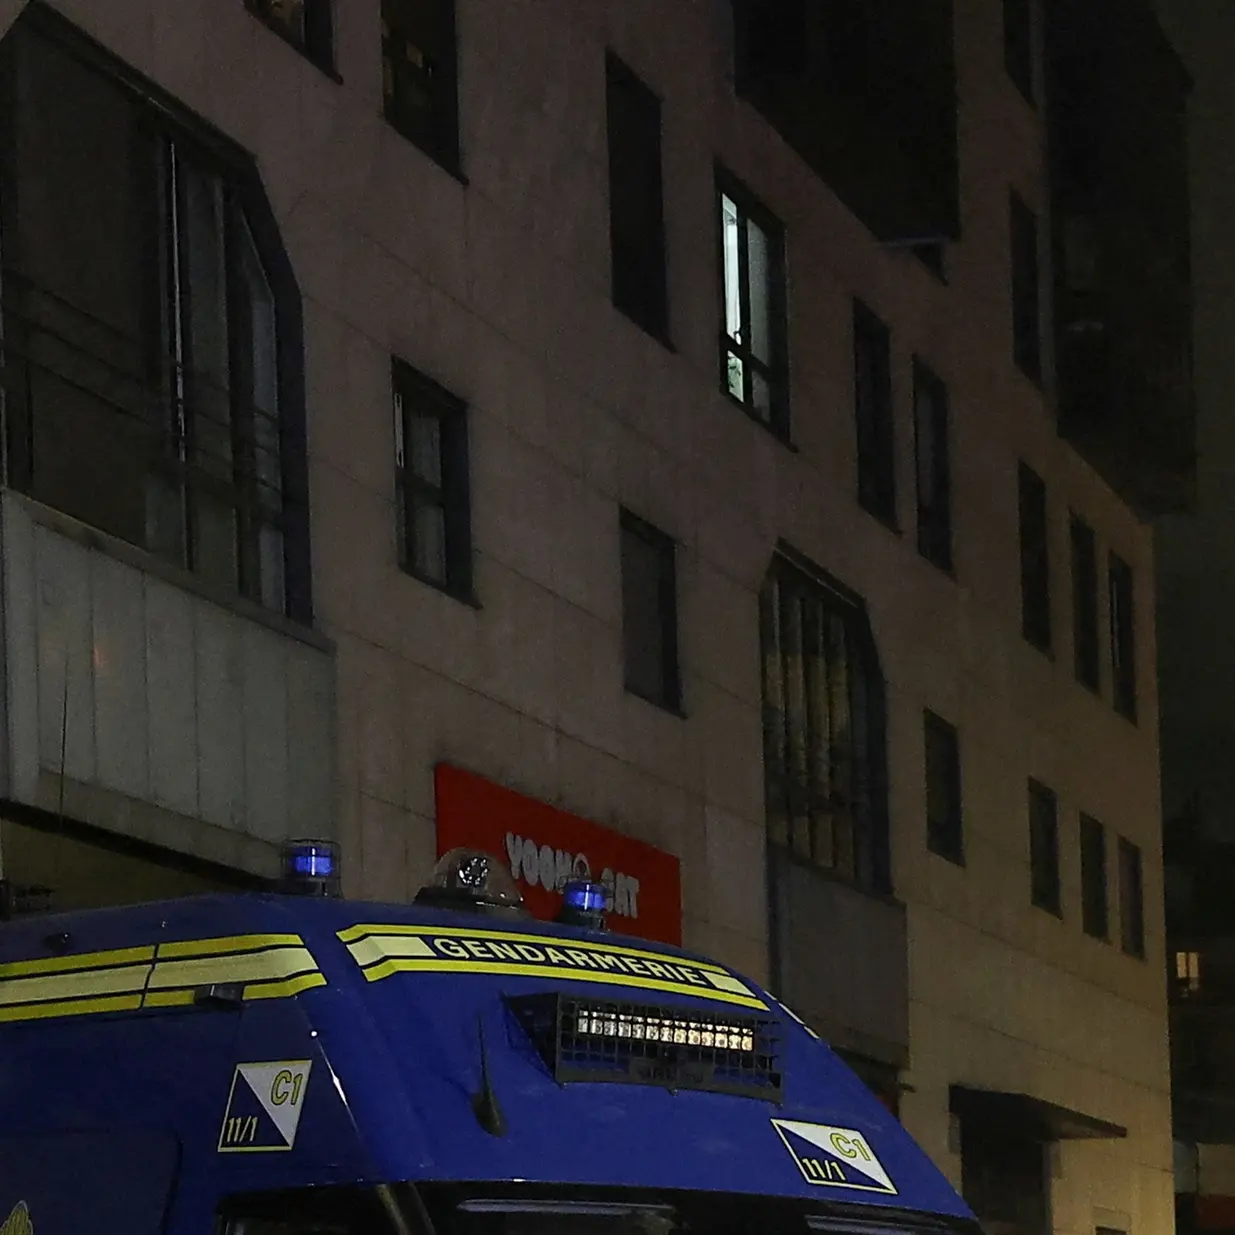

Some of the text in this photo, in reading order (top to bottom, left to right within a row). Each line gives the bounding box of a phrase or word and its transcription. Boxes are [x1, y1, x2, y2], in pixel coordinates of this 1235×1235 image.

[434, 938, 708, 985] GENDARMERIE
[271, 1069, 304, 1106] C1
[226, 1115, 258, 1143] 11/1
[829, 1132, 871, 1162] C1
[801, 1157, 847, 1181] 11/1
